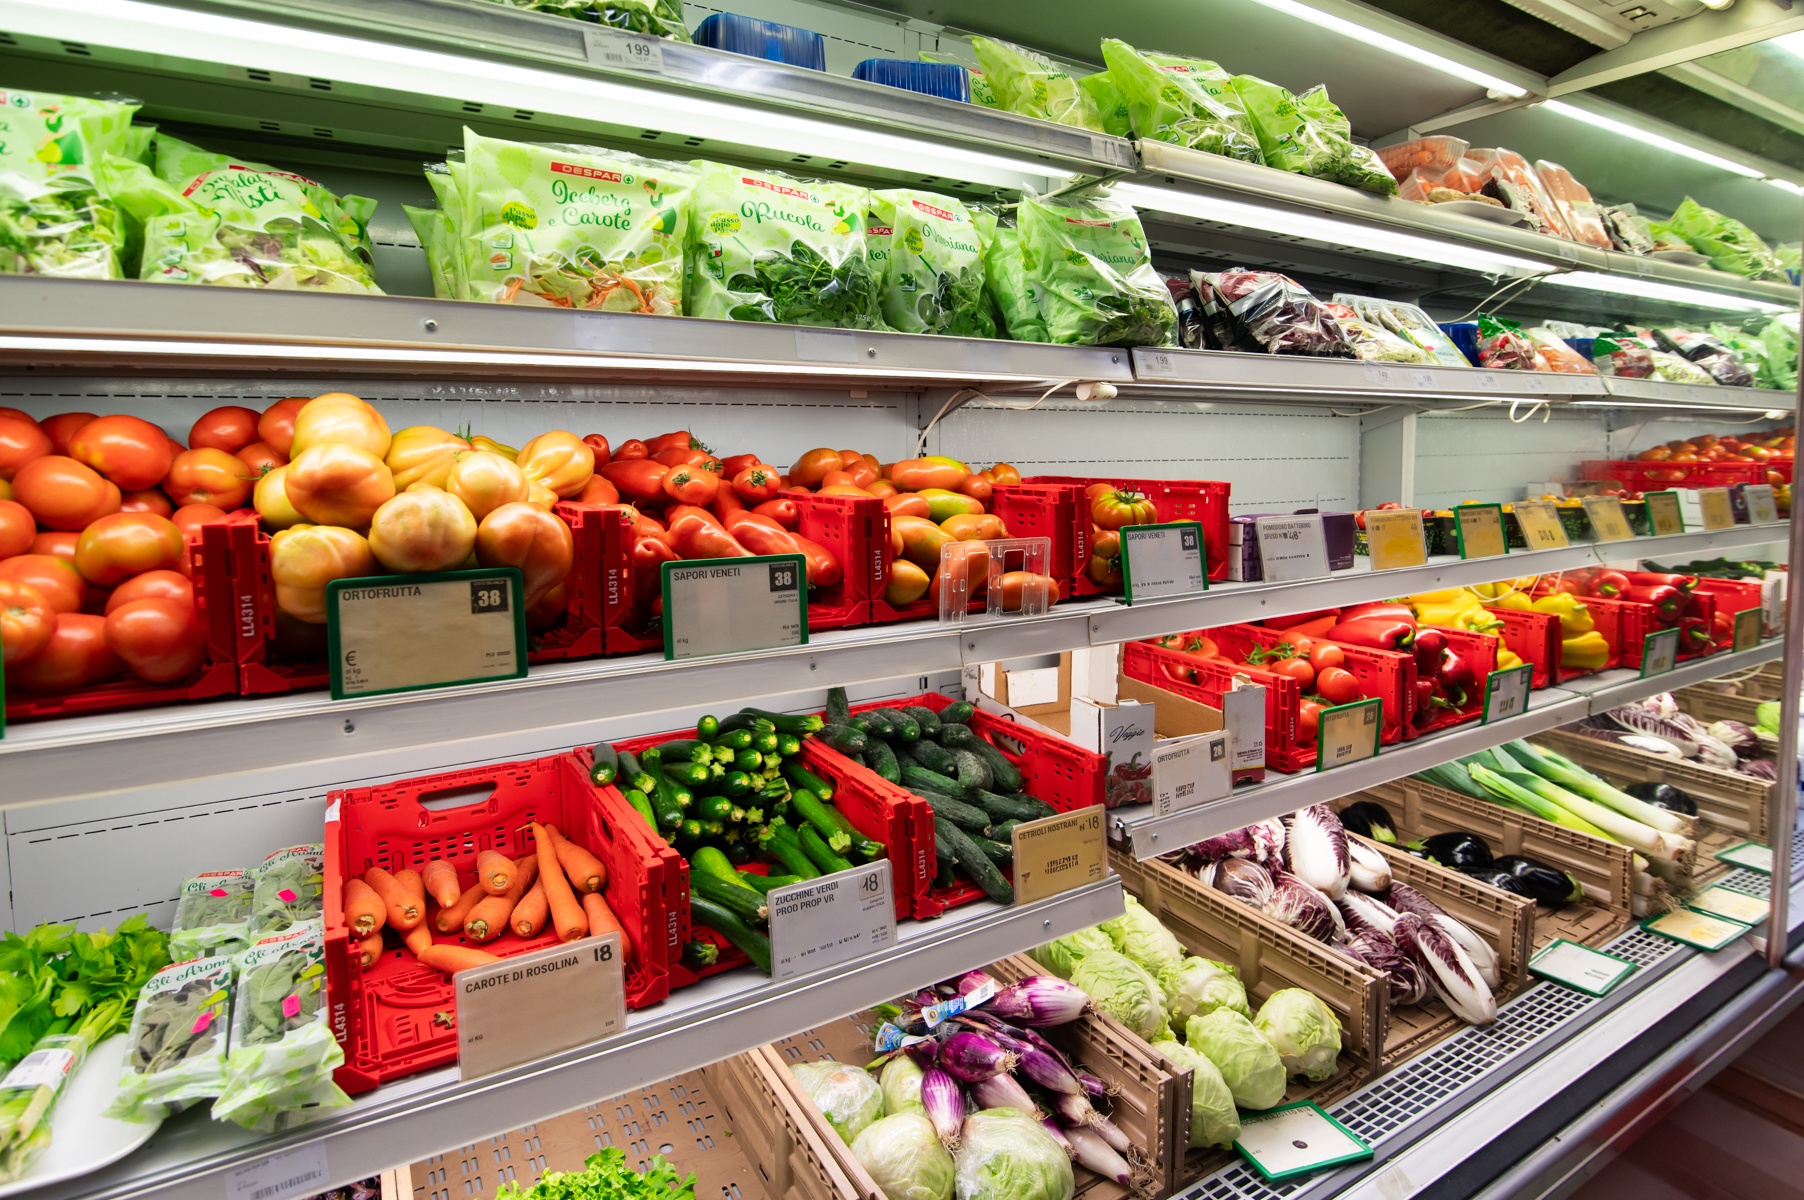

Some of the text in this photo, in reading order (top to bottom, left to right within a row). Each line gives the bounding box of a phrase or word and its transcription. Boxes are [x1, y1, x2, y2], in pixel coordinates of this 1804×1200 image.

[562, 164, 622, 182] DESPAR
[552, 179, 632, 216] Iceberg
[753, 179, 809, 200] DESPAR
[503, 211, 526, 226] dopo
[510, 207, 535, 220] Passo
[548, 206, 633, 231] e Carote
[715, 216, 740, 224] Passo
[741, 201, 825, 233] Rucola
[918, 203, 954, 220] DESPAR
[710, 221, 731, 230] dopo
[1262, 522, 1312, 531] POMODORO DATTERINO
[1077, 531, 1085, 559] LL4314
[1127, 531, 1166, 541] SAPORI VENETI
[1184, 535, 1194, 547] 38
[1264, 532, 1278, 540] SFUSO
[673, 567, 741, 581] SAPORI VENETI
[874, 550, 882, 581] LL4314
[608, 568, 618, 605] LL4314
[774, 571, 792, 586] 38
[342, 586, 422, 601] ORTOFRUTTA
[477, 590, 501, 607] 38
[240, 594, 255, 637] LL4314
[345, 650, 357, 667] €
[1109, 723, 1145, 744] Veggie
[1157, 748, 1190, 764] ORTOFRUTTA
[1018, 828, 1047, 841] CETRIOLI
[1047, 819, 1078, 833] NOSTRANI
[917, 849, 927, 880] LL4314
[862, 872, 879, 892] 18
[775, 881, 839, 906] ZUCCHINE VERDI
[776, 893, 835, 917] PROD PROP VR
[264, 929, 308, 945] DESPAR
[668, 911, 678, 947] LL4314
[244, 948, 267, 966] Gli
[594, 944, 613, 962] 18
[465, 956, 579, 994] CAROTE DI ROSOLINA
[146, 976, 171, 993] Gli
[334, 1002, 348, 1043] LL4314
[605, 1019, 615, 1027] EUR
